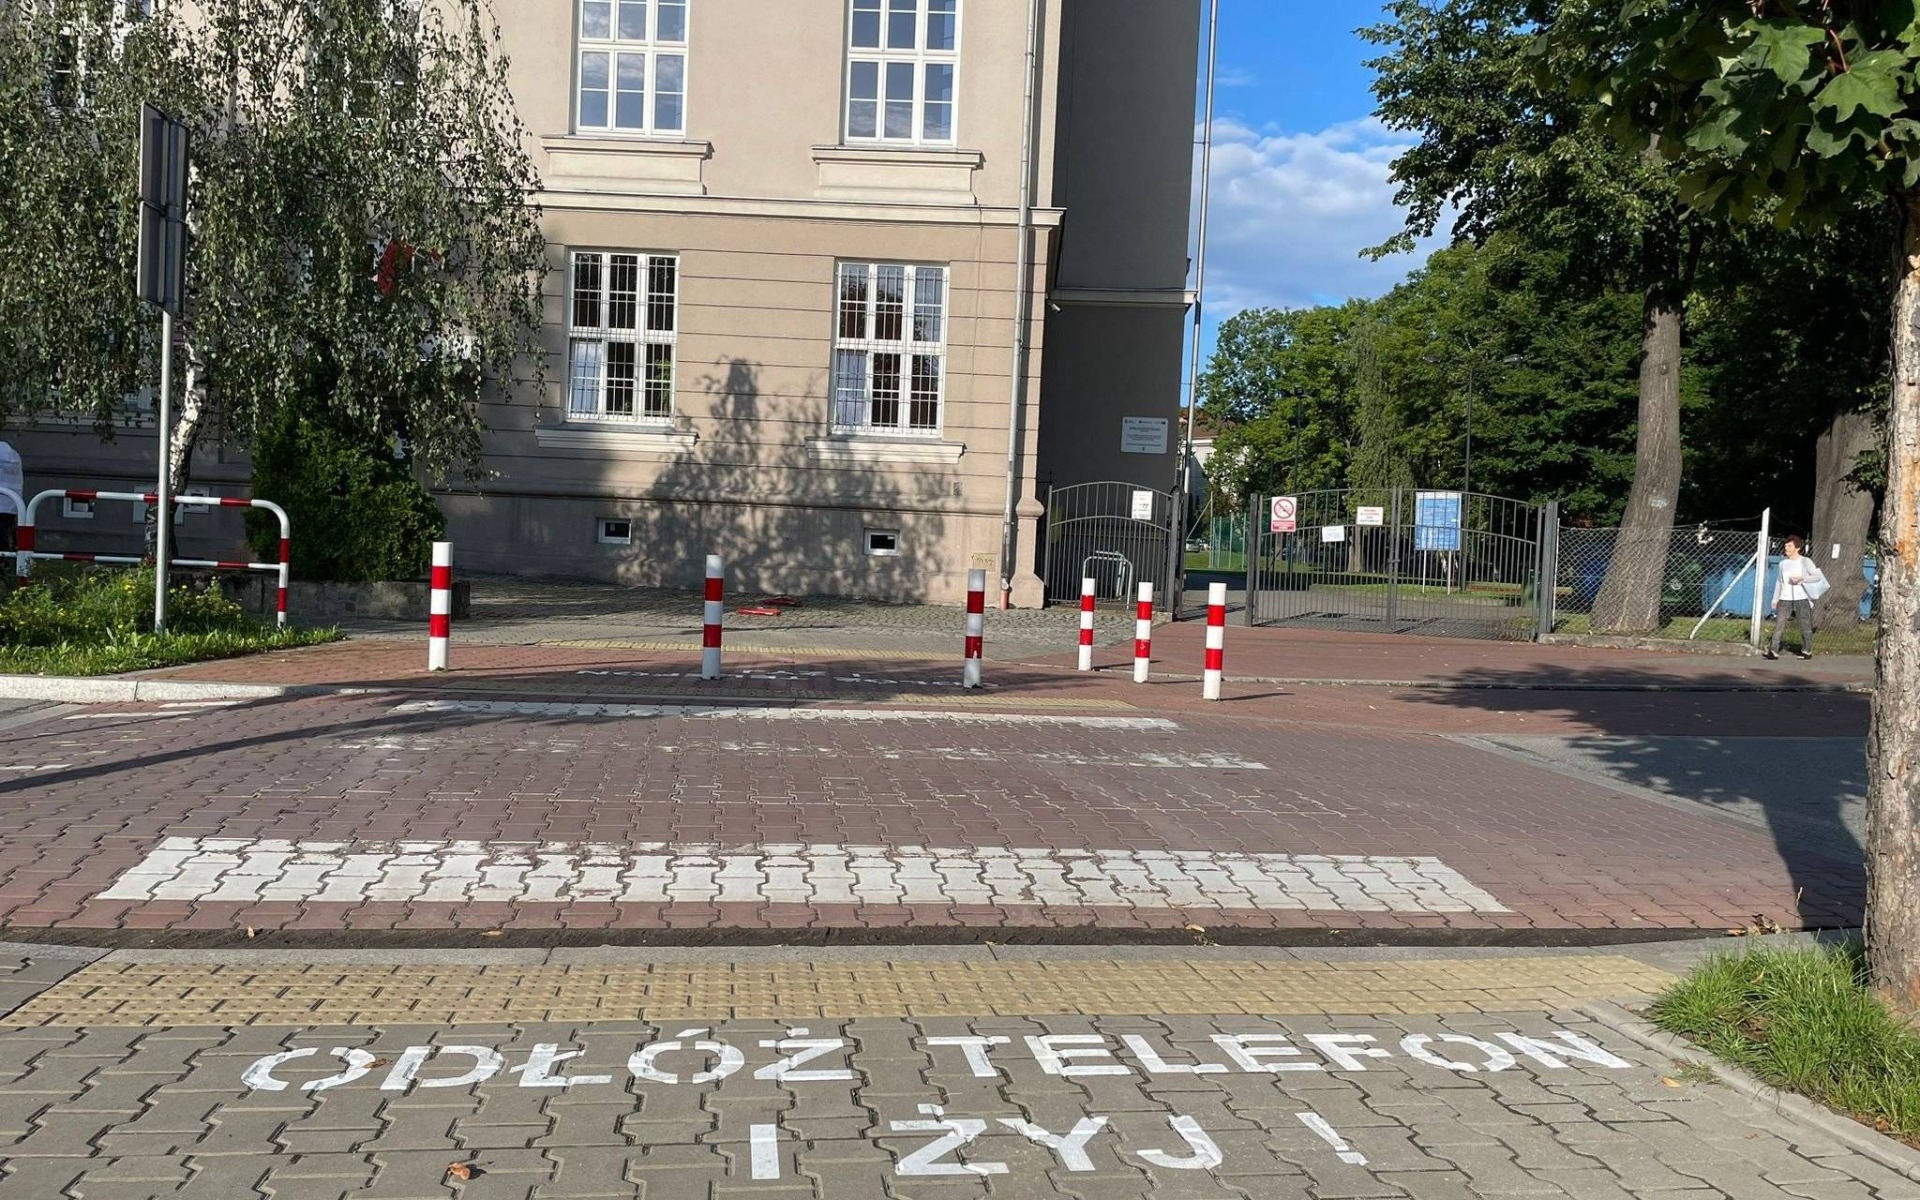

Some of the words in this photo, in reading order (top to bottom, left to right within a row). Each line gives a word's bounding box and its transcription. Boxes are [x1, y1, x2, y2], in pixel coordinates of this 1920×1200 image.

[241, 1027, 854, 1092] ODŁÓŻ
[926, 1031, 1633, 1079] TELEFON
[749, 1124, 781, 1181] I
